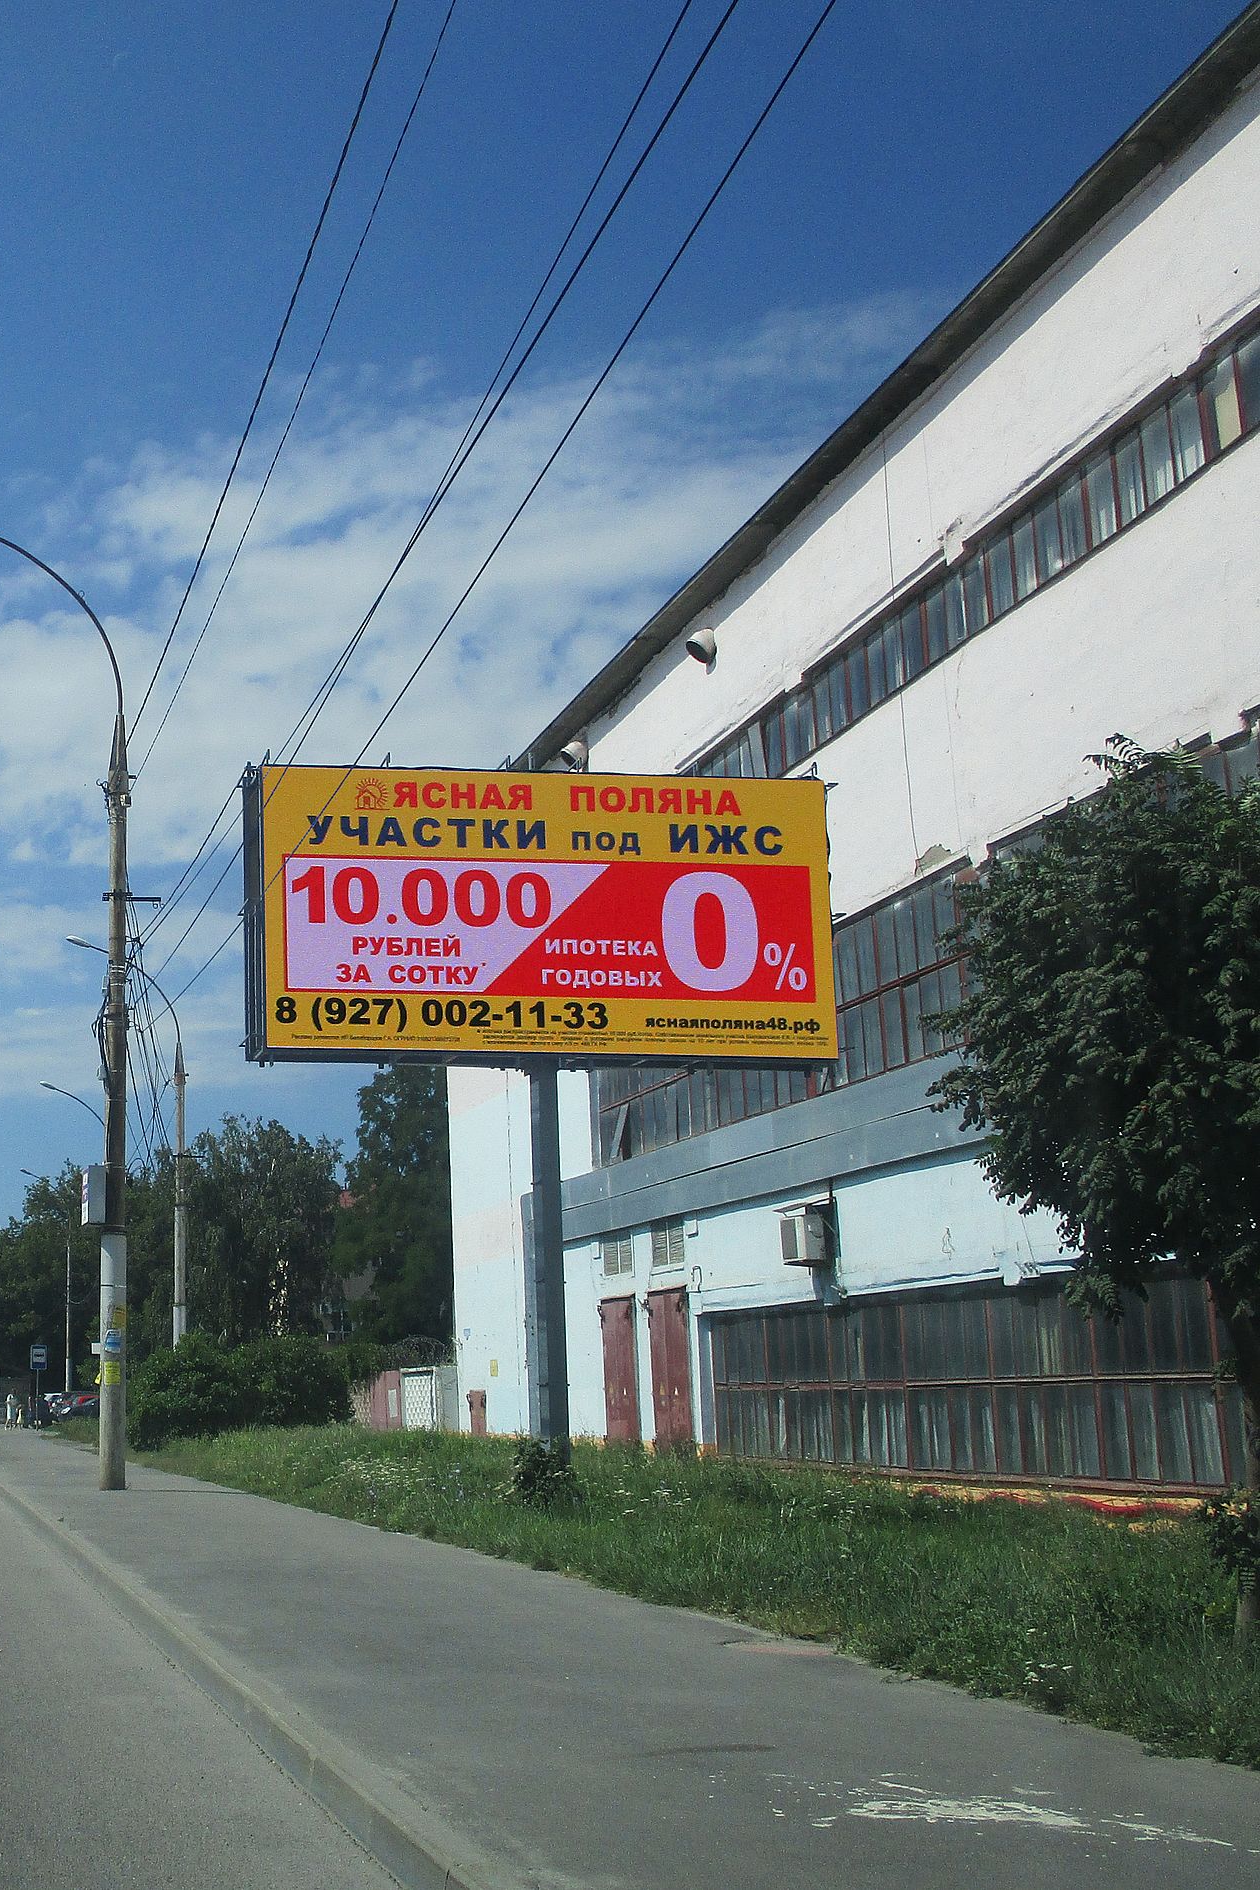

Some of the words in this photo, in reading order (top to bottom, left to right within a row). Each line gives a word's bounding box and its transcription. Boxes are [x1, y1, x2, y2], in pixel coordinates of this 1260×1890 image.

[393, 782, 532, 810] ЯСНАЯ
[570, 785, 741, 815] ПОЛЯНА
[307, 815, 546, 849] УЧАСТКИ
[571, 831, 641, 855] под
[669, 824, 783, 855] ИЖС
[292, 866, 551, 928] 10.000
[352, 933, 461, 957] РУБЛЕЙ
[545, 939, 658, 956] ИПОТЕКА
[336, 964, 372, 983] ЗА
[541, 969, 662, 989] ГОДОВЫХ
[275, 996, 297, 1024] 8
[311, 997, 407, 1032] (927)
[421, 999, 608, 1029] 002-11-33
[645, 1017, 820, 1034] яснаяполяна48.рф
